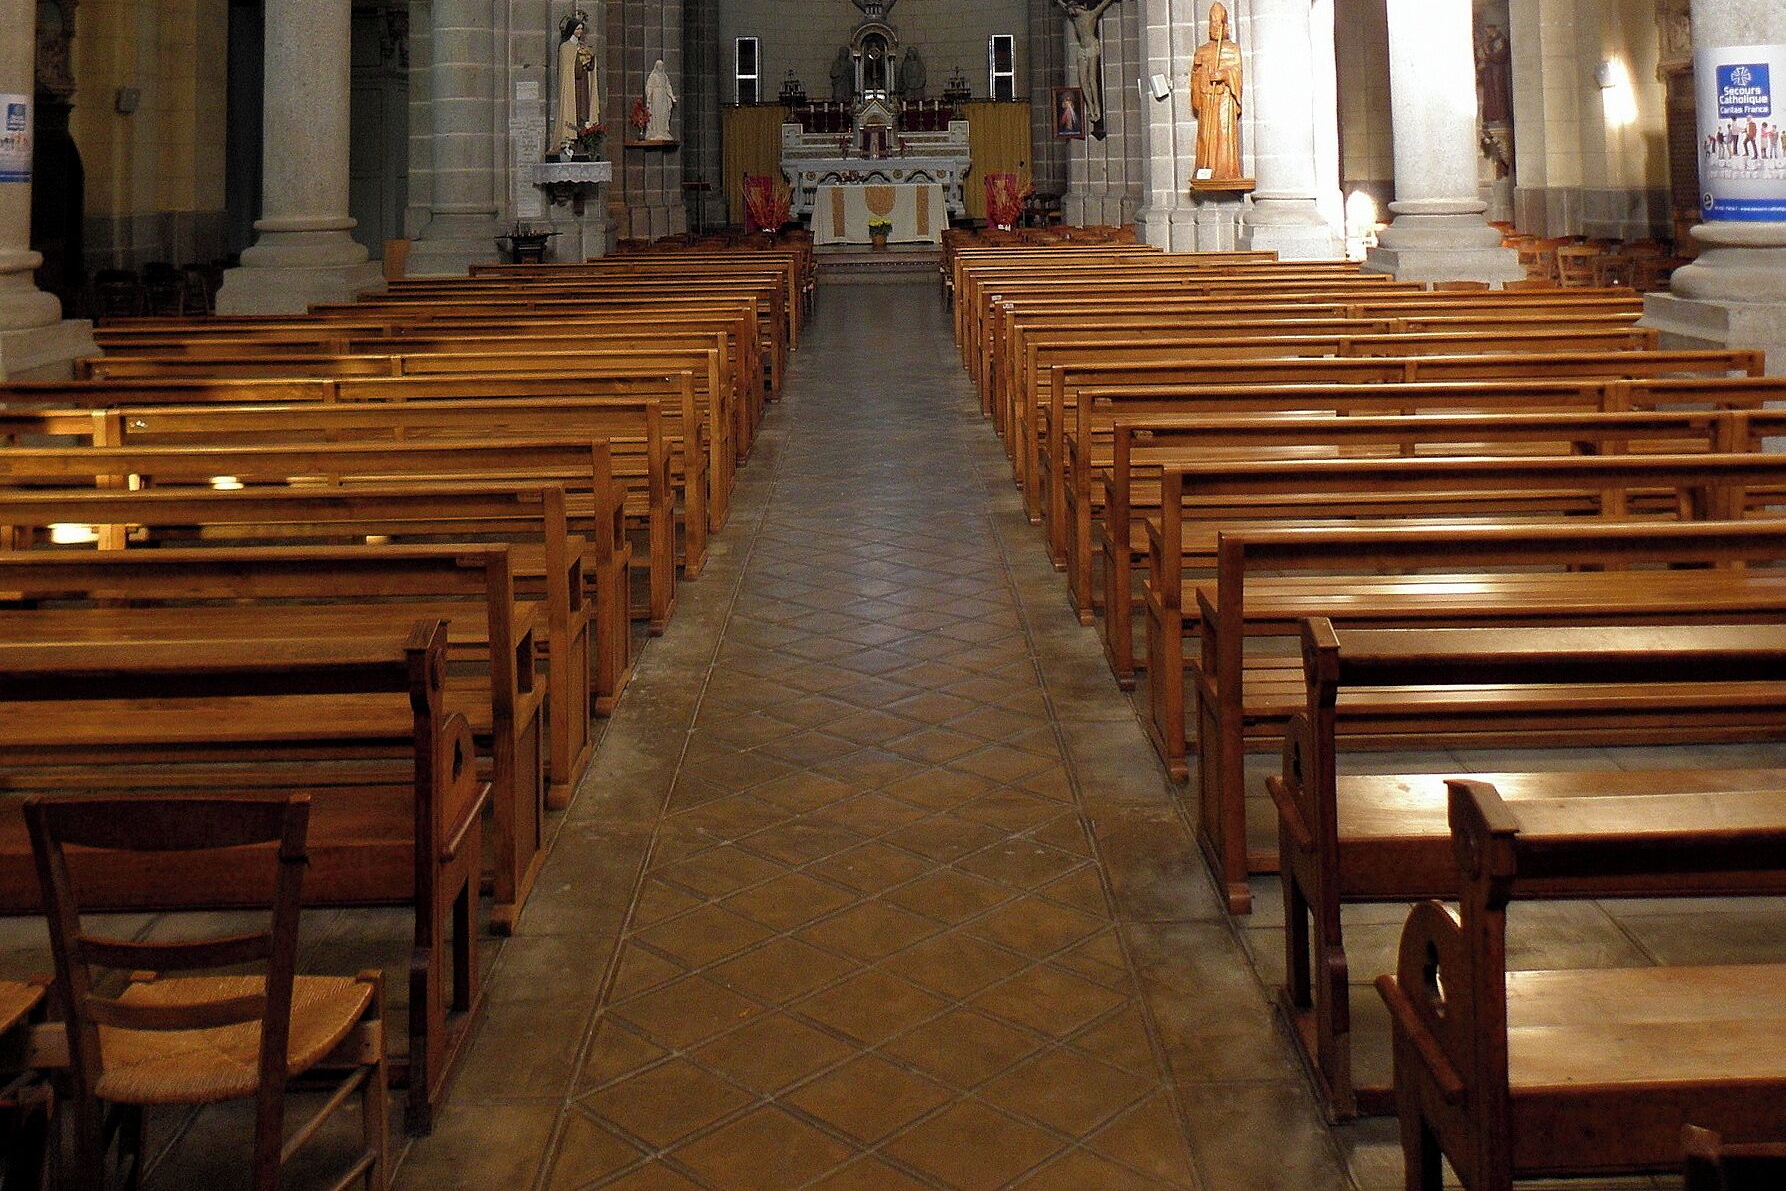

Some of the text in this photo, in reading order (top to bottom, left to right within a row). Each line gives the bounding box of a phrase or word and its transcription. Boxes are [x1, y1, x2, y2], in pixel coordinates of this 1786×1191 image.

[1723, 86, 1761, 95] Secours
[1719, 94, 1768, 105] Catholique
[1720, 106, 1743, 114] Caritas
